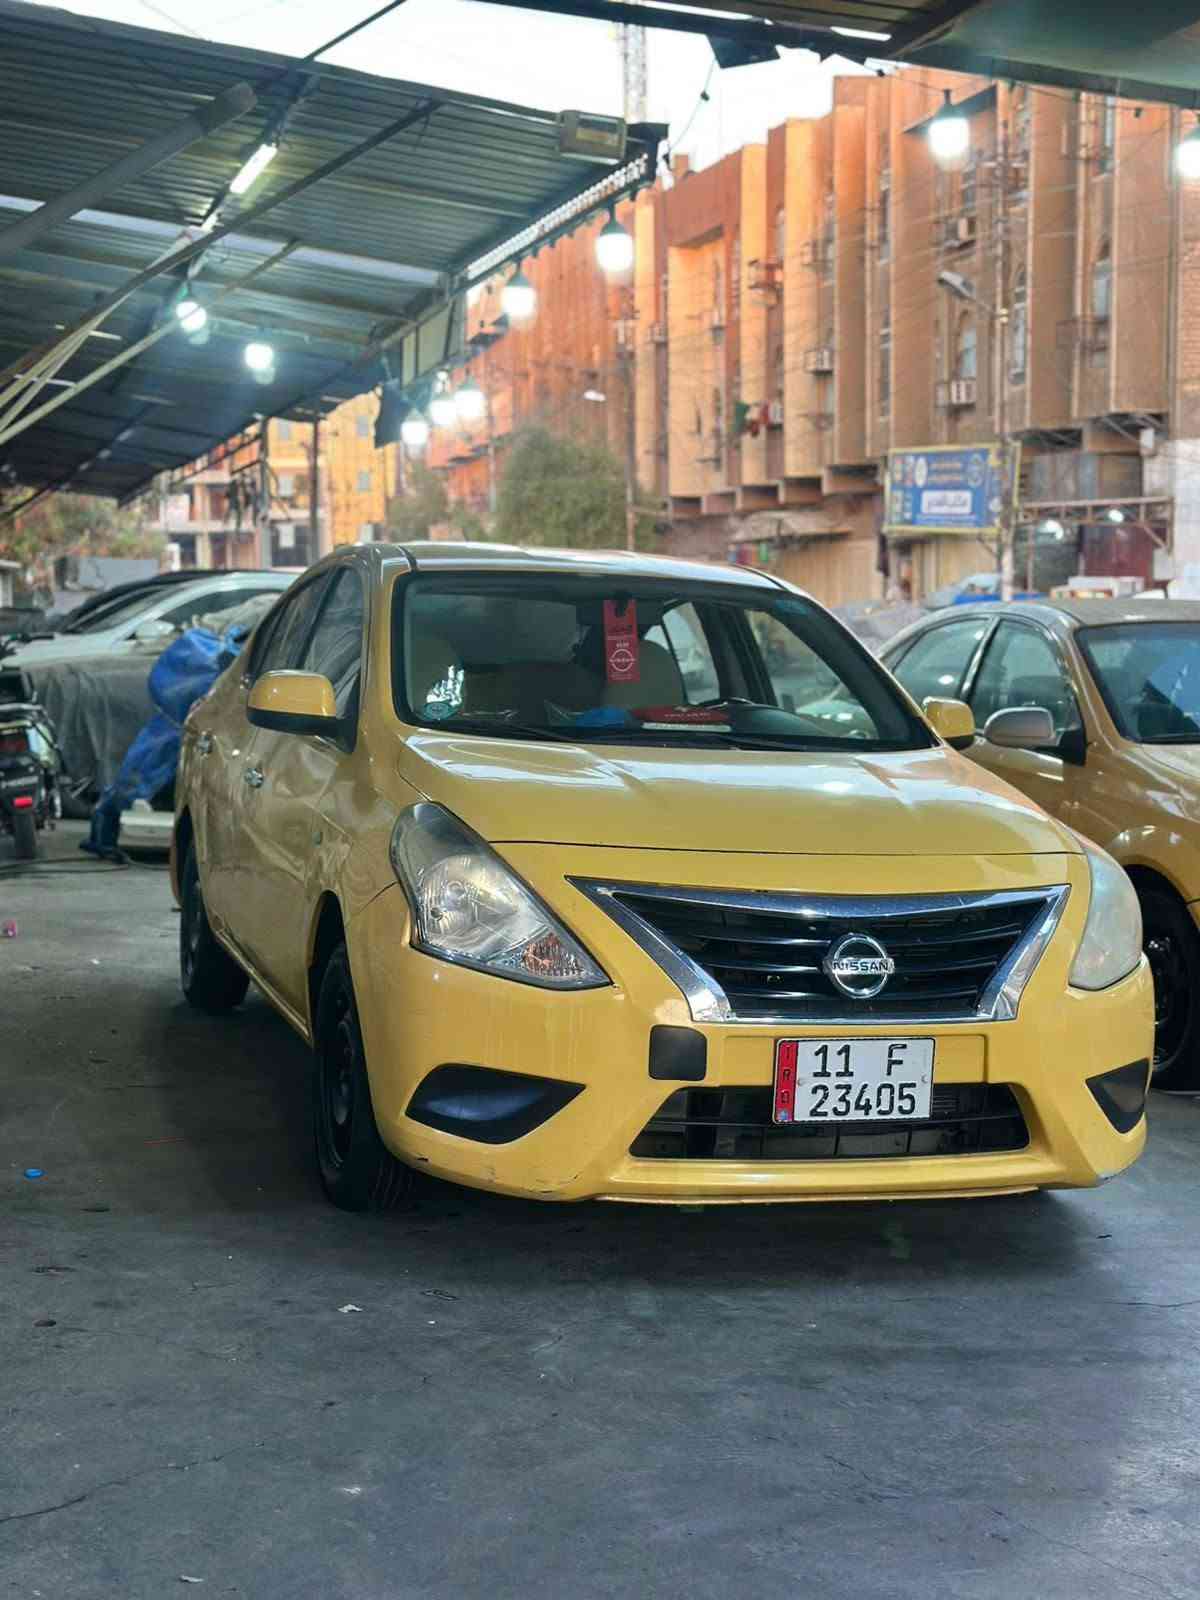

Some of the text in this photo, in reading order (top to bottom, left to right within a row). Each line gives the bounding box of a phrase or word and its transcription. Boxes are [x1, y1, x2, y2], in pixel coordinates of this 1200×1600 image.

[832, 960, 889, 971] NISSAN
[813, 1043, 908, 1077] 11 F
[809, 1082, 917, 1117] 23405
